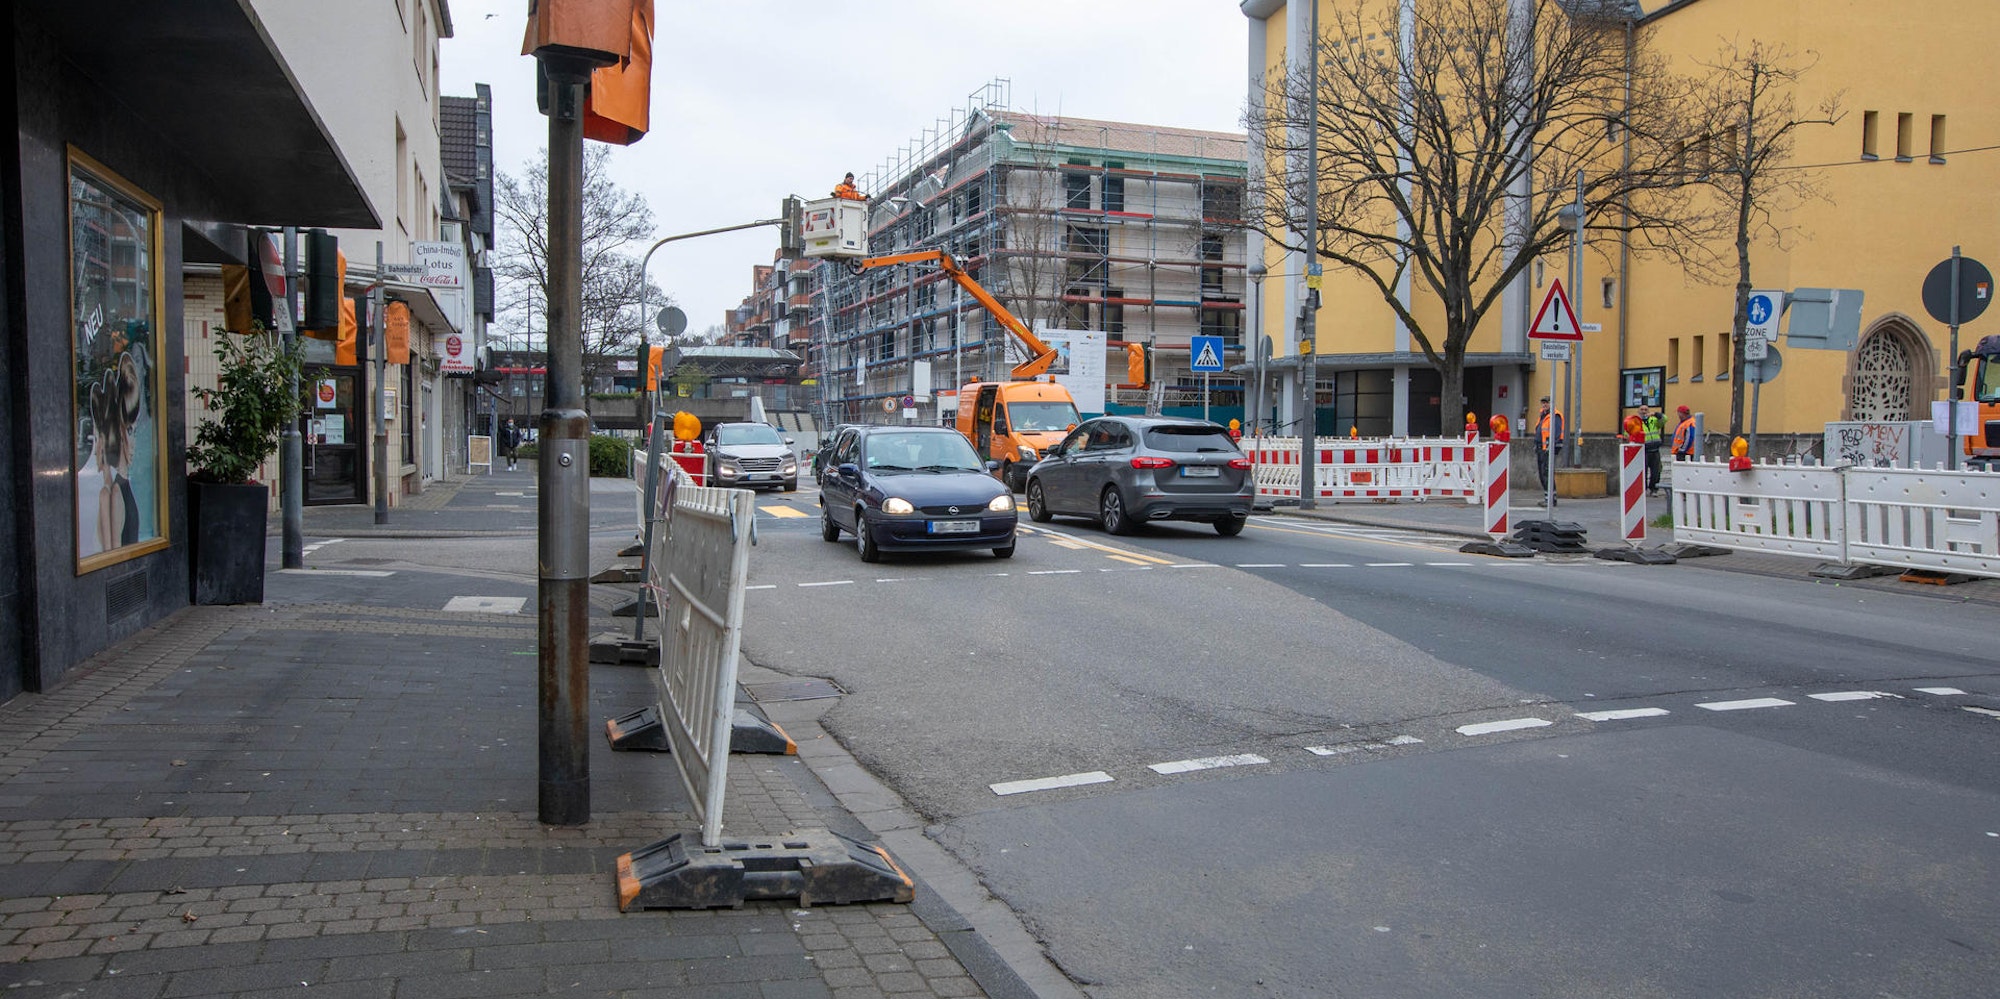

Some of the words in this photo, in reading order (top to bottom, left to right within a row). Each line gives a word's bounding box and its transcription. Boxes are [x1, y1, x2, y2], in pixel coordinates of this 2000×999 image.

[416, 245, 462, 257] China-Imbiß
[388, 265, 424, 274] Bahnhofstr.
[84, 303, 103, 345] NEU
[1745, 327, 1767, 337] ZONE
